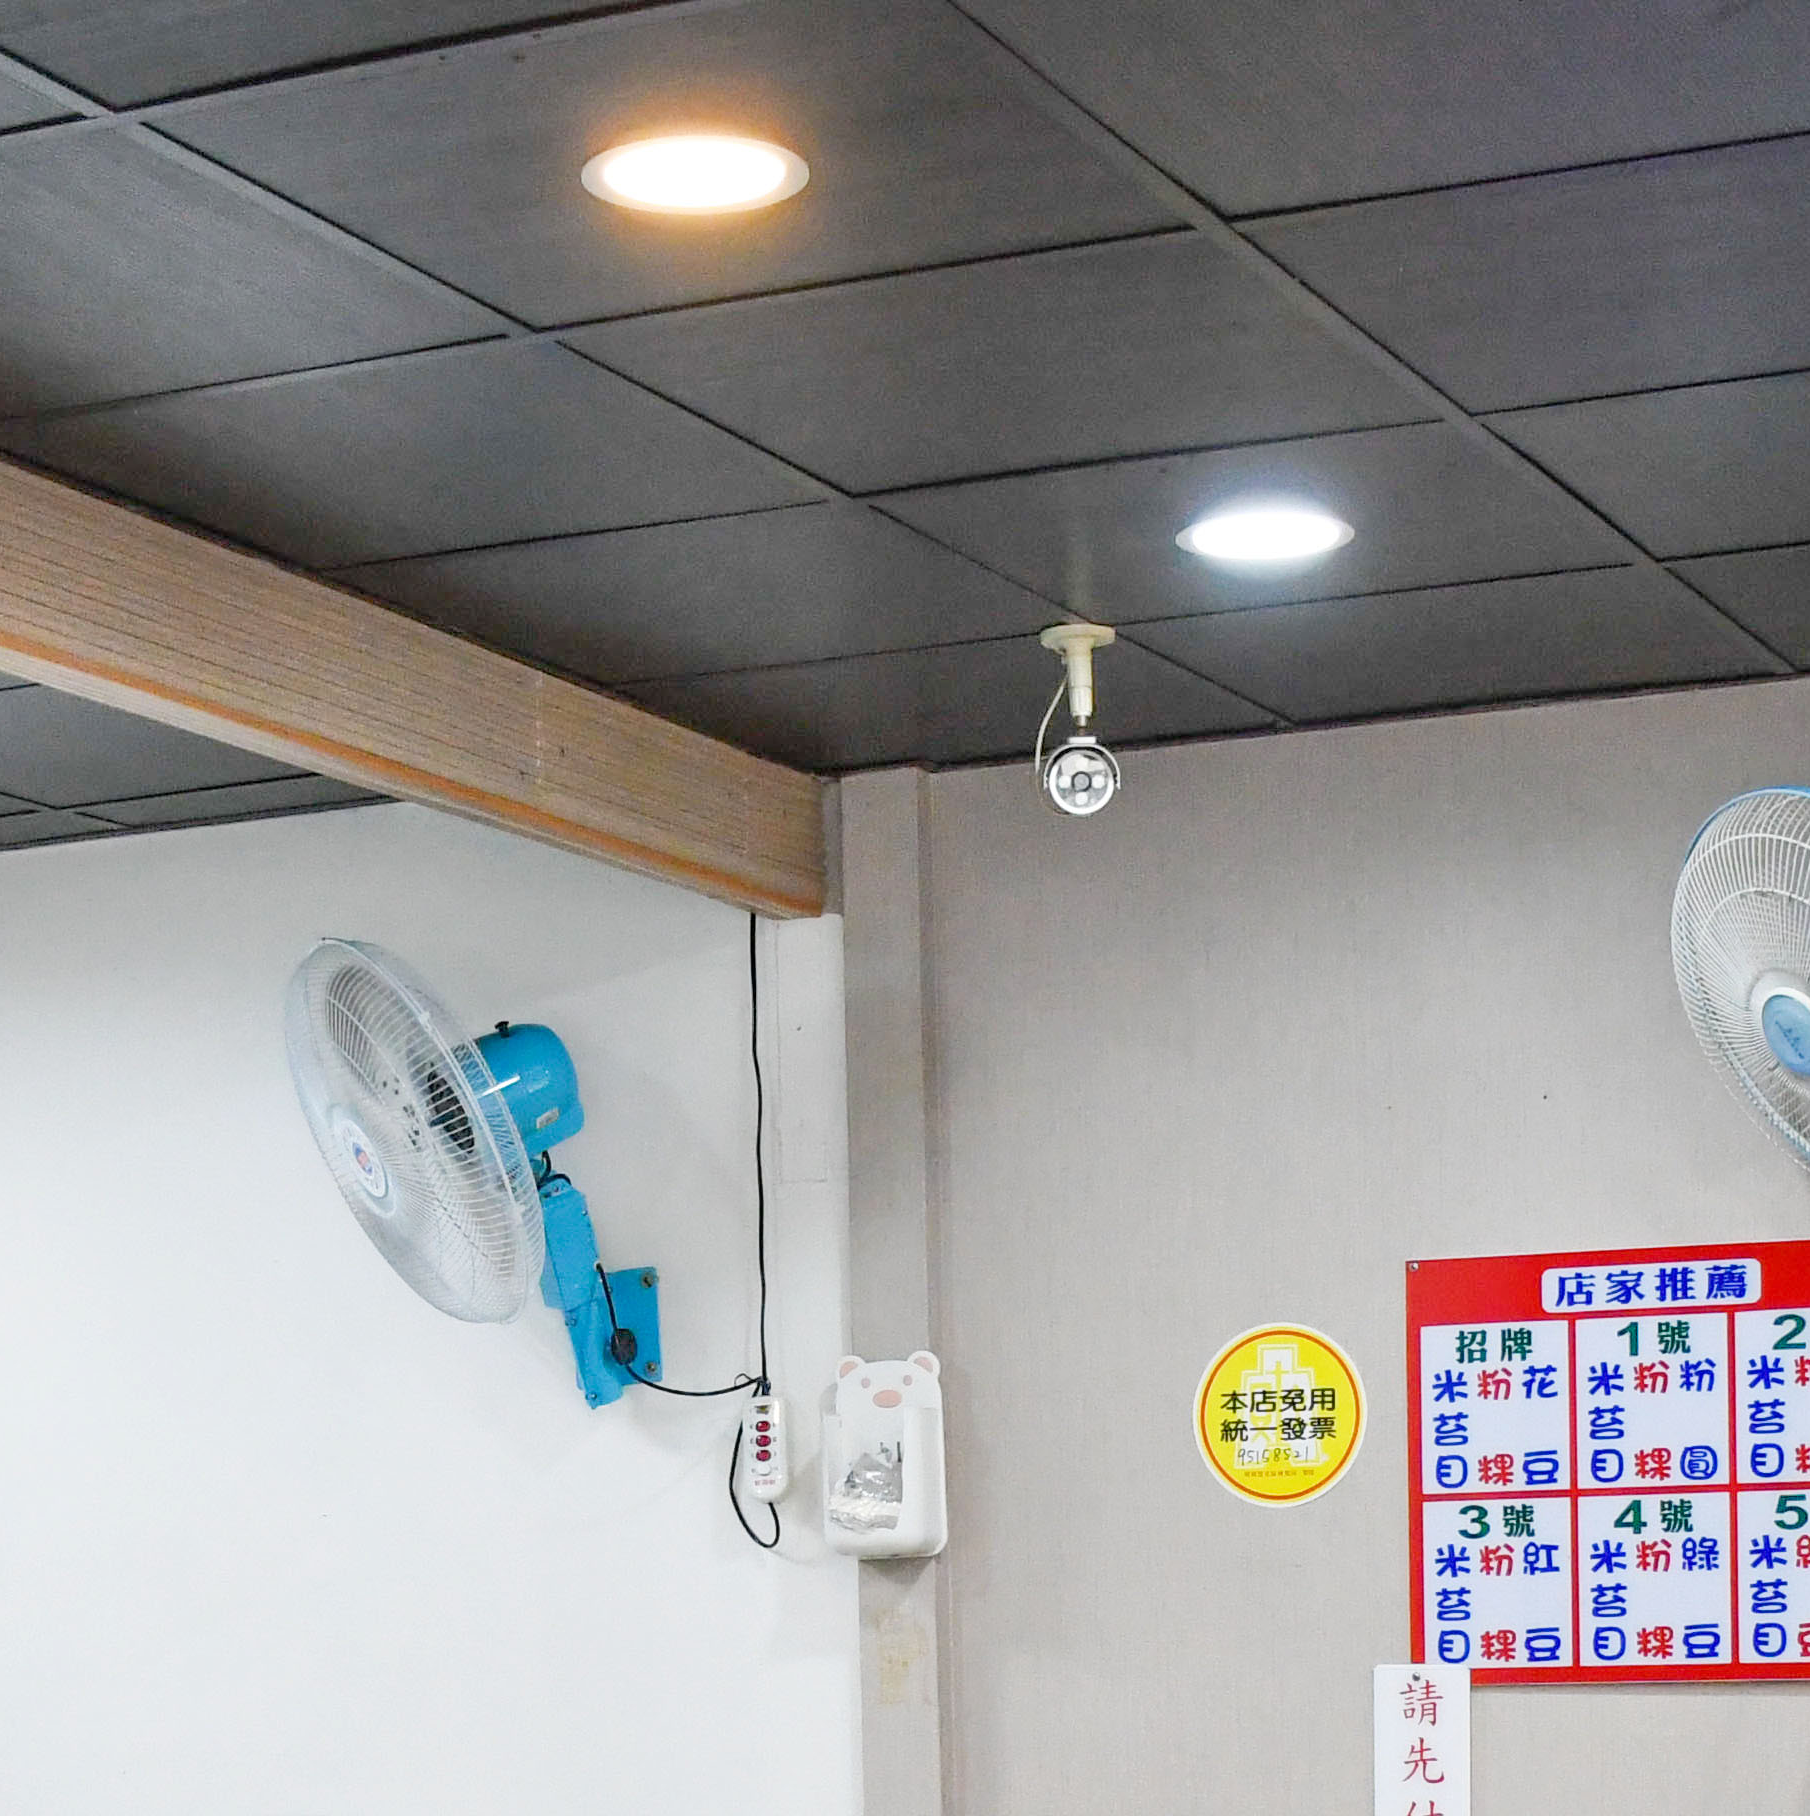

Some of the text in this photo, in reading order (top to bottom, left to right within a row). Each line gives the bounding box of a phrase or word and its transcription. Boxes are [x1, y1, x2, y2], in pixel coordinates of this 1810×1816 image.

[1555, 1263, 1749, 1308] 店家推薦
[1456, 1327, 1534, 1364] 招牌
[1618, 1319, 1692, 1357] 1號
[1220, 1387, 1336, 1414] 本店免用
[1220, 1416, 1336, 1443] 統一發票
[1458, 1503, 1536, 1539] 3號
[1614, 1499, 1694, 1534] 4號
